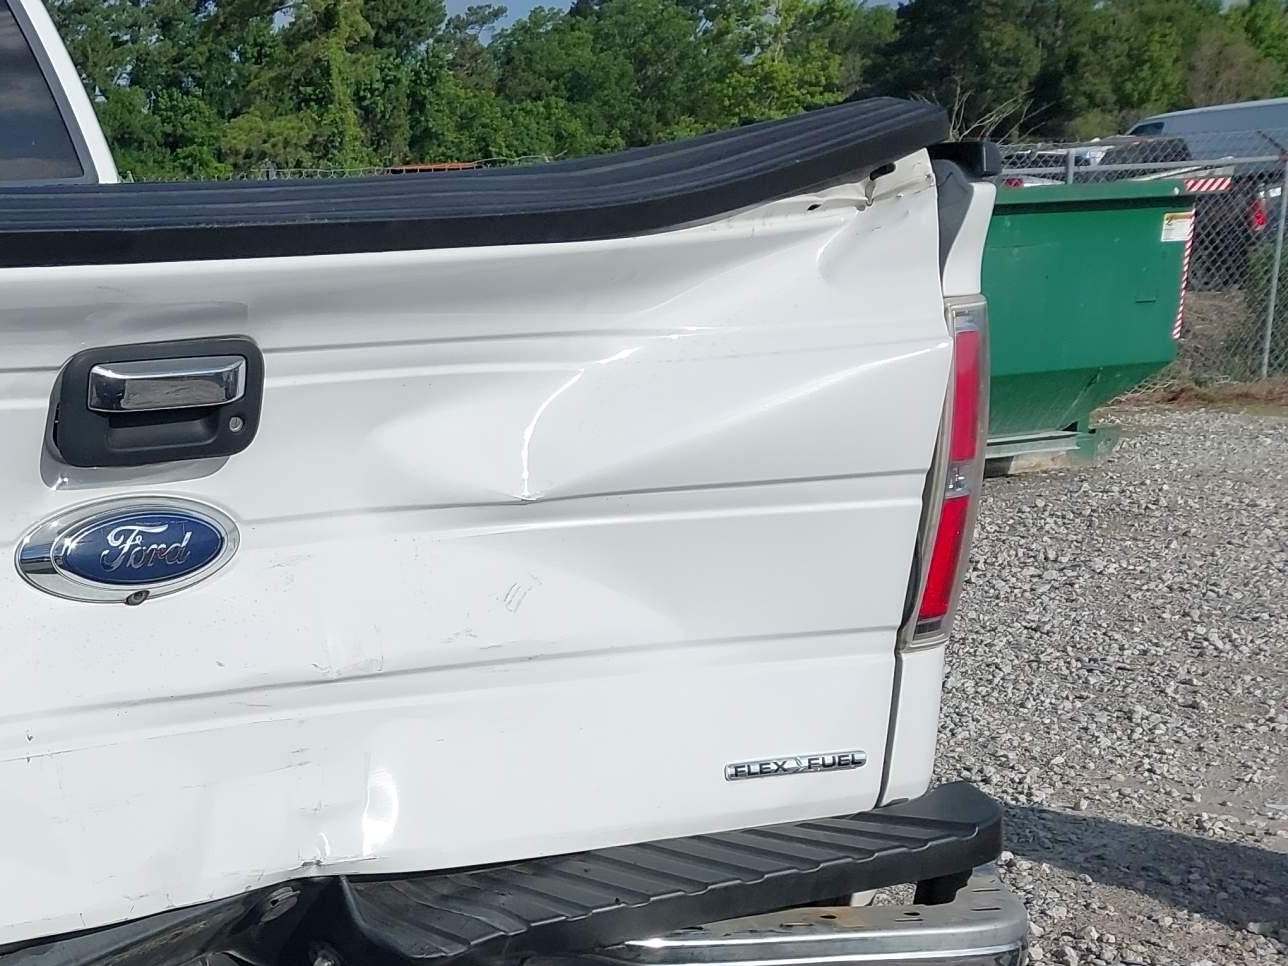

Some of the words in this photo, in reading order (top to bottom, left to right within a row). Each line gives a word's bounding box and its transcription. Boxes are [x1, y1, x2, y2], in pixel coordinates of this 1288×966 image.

[101, 523, 192, 573] Ford
[733, 760, 789, 777] FLEX
[807, 753, 862, 770] FUEL
